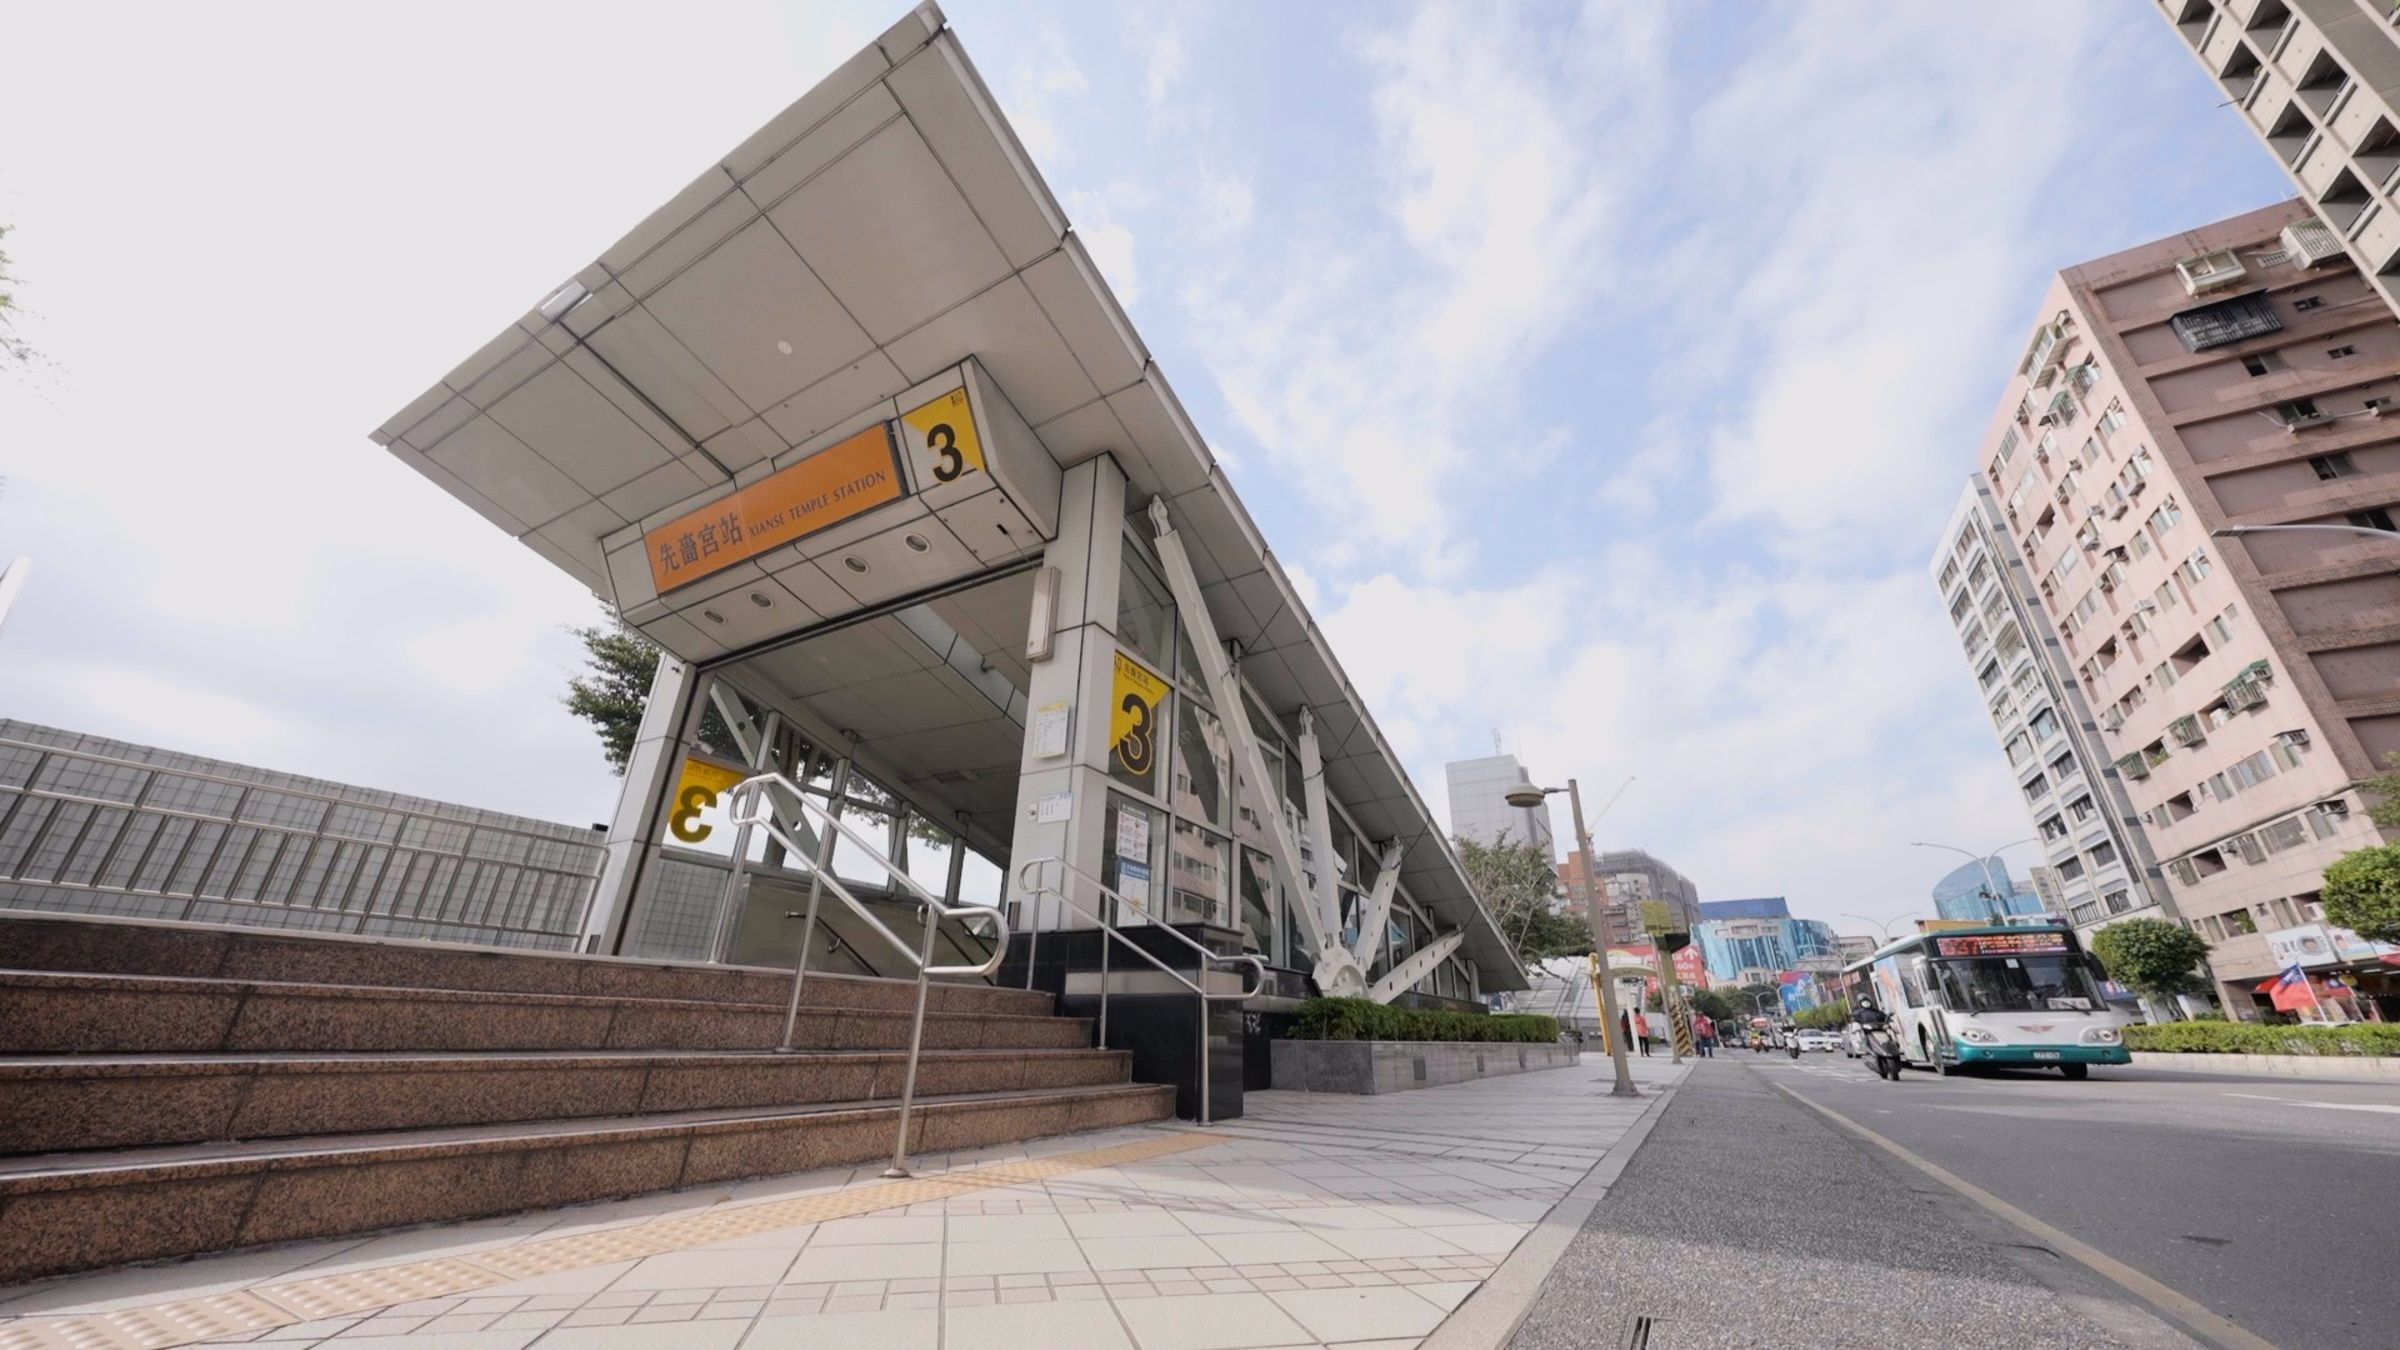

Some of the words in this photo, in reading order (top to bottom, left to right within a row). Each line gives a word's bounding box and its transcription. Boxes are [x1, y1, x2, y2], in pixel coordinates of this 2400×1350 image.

[927, 423, 963, 482] 3
[749, 513, 786, 539] XIANSE
[789, 496, 830, 521] TEMPLE
[832, 469, 887, 502] STATION
[659, 510, 743, 575] 先嗇宮站
[1119, 692, 1152, 774] 3
